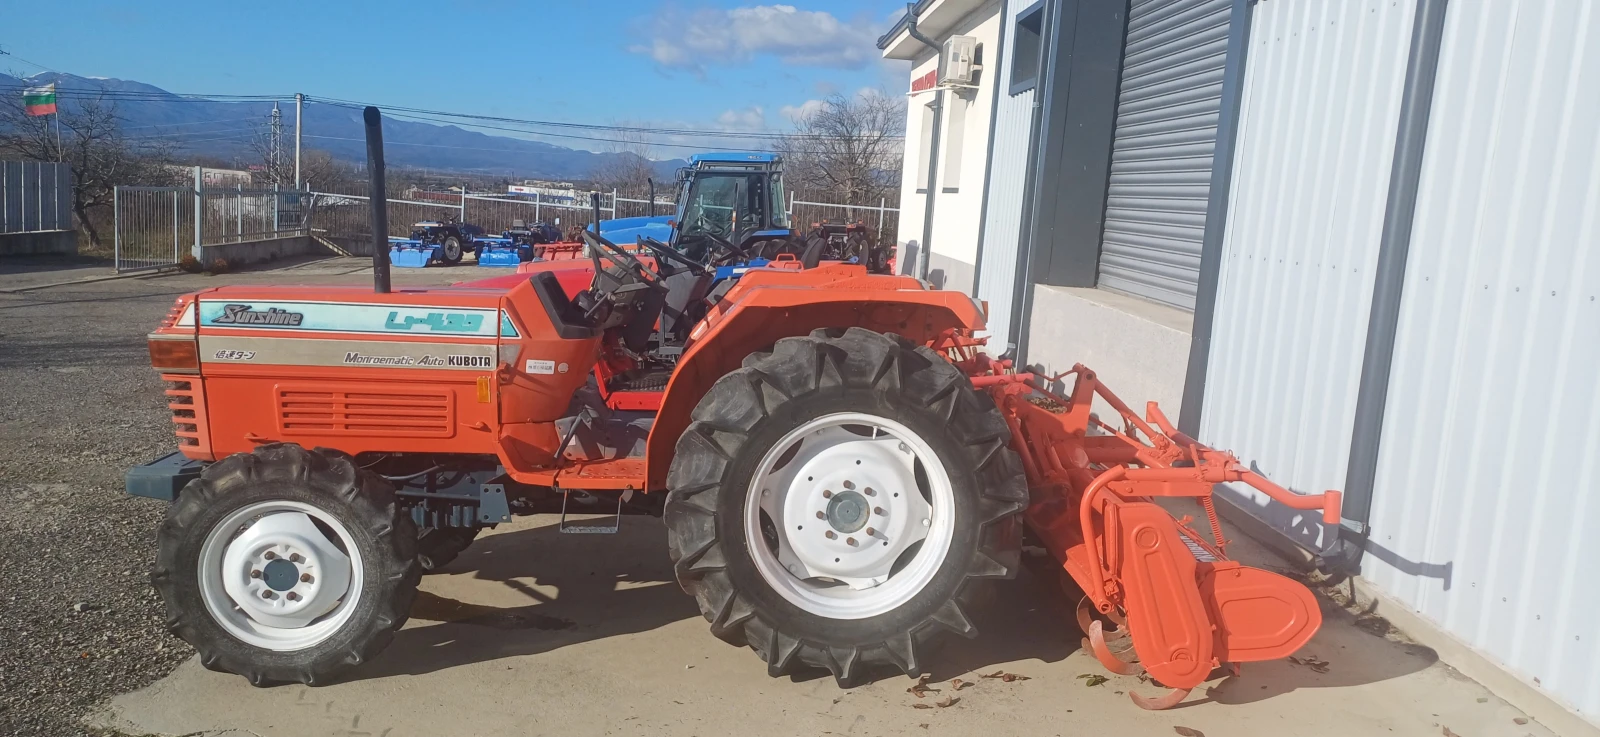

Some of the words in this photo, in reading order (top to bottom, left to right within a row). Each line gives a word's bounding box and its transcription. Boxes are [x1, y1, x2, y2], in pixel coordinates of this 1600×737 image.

[211, 304, 303, 326] Sunshine
[214, 349, 256, 360] 倍速ターン
[344, 352, 414, 366] Monroematic
[417, 355, 445, 366] Auto
[448, 355, 491, 367] KUBOTA
